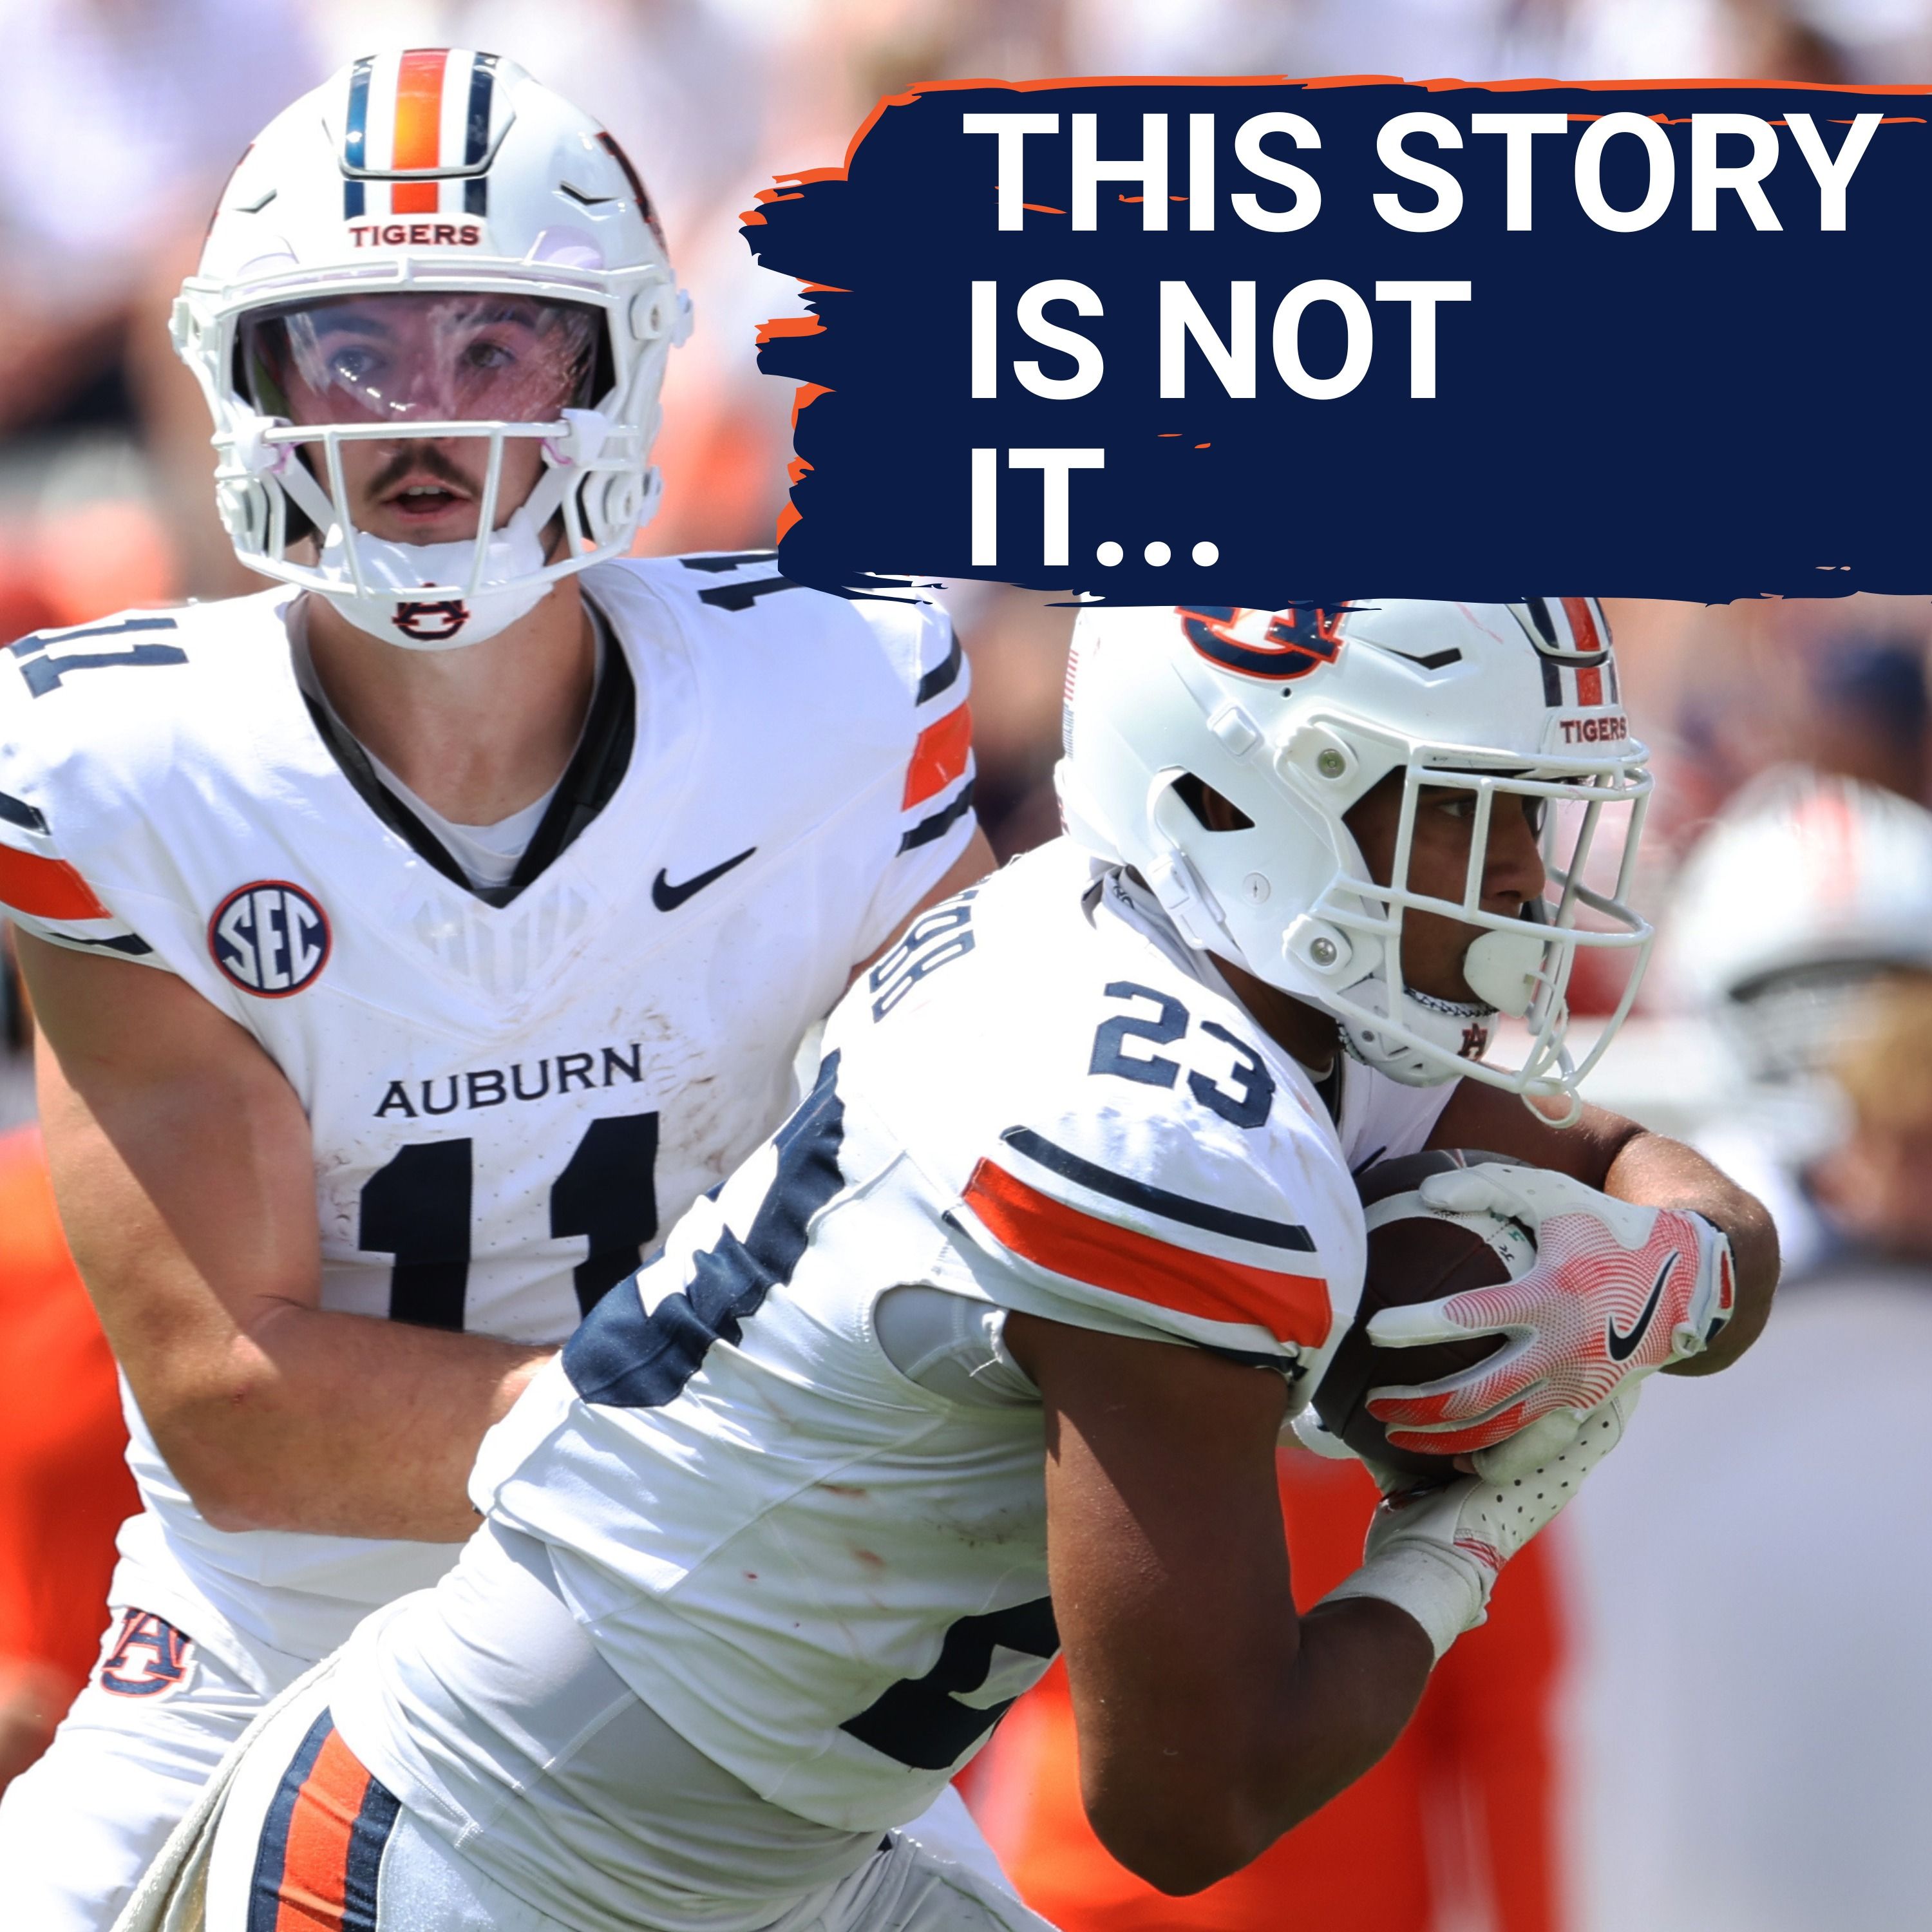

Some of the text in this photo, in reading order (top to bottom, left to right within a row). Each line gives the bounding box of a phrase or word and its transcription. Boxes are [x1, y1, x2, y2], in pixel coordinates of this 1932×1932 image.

[348, 224, 480, 247] TIGERS
[1559, 716, 1627, 744] TIGERS
[218, 889, 321, 990] SEC
[373, 1043, 645, 1118] AUBURN
[1088, 981, 1276, 1128] 23
[359, 1111, 659, 1333] 11
